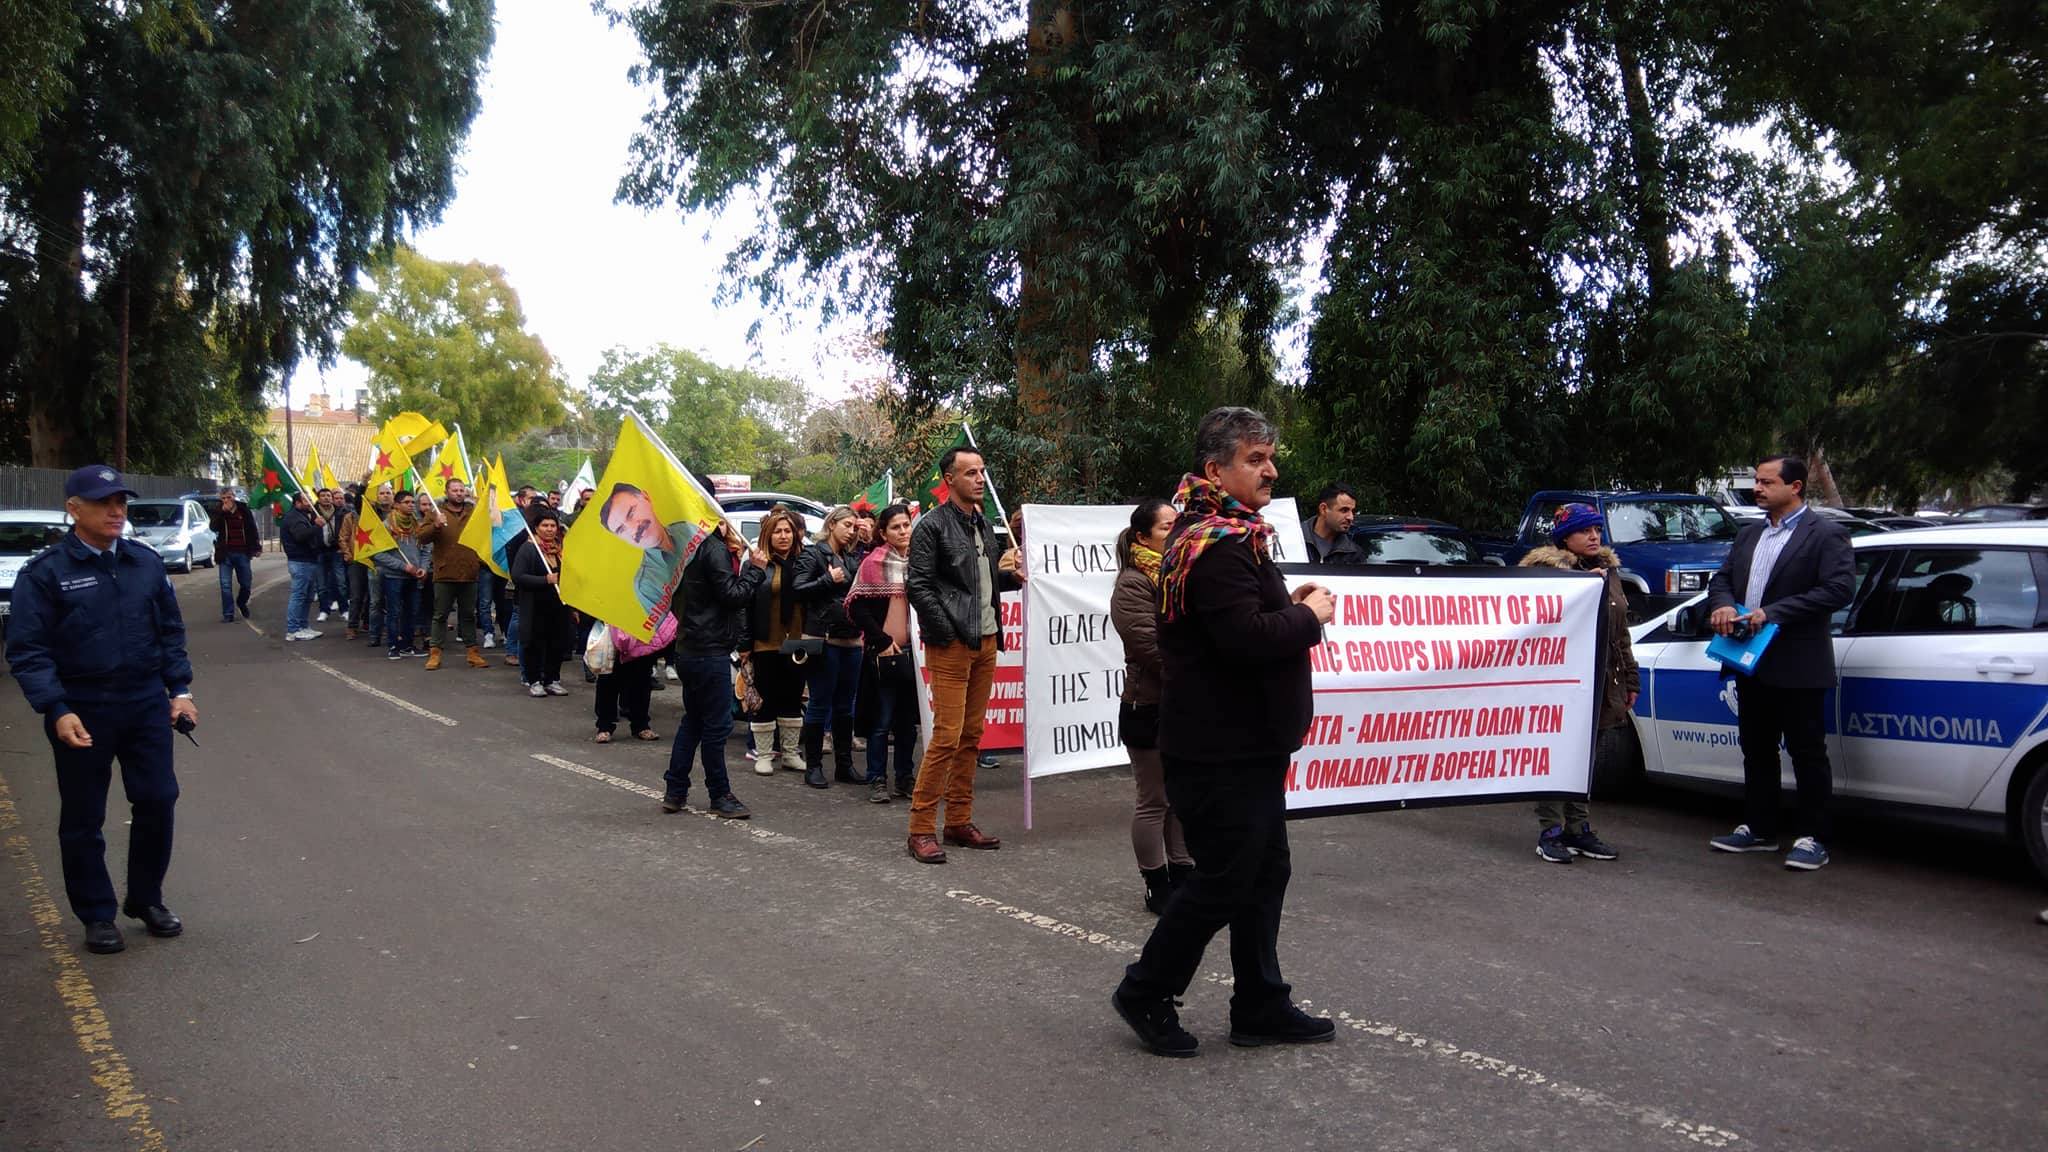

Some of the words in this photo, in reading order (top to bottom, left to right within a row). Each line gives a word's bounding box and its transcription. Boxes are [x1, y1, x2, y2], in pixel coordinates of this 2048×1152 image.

[1043, 543, 1060, 574] Η
[1343, 594, 1384, 626] AND
[1388, 594, 1502, 626] SOLIDARITY
[1507, 594, 1531, 625] OF
[1535, 594, 1563, 625] ALL
[1048, 613, 1109, 646] ΘΕΛΕΙ
[1345, 639, 1429, 672] GROUPS
[1431, 639, 1454, 671] IN
[1457, 638, 1519, 670] NORTH
[1517, 636, 1567, 667] SYRIA
[1048, 671, 1090, 705] ΤΗΣ
[1356, 708, 1474, 744] ΑΛΛΗΛΕΓΓΥΗ
[1475, 706, 1526, 737] ΟΛΩΝ
[1528, 704, 1564, 734] ΤΩΝ
[1847, 711, 2003, 744] ΑΣΤΥΝΟΜΙΑ
[1305, 756, 1393, 791] ΟΜΑΔΩΝ
[1391, 753, 1430, 785] ΣΤΗ
[1430, 749, 1497, 782] ΒΟΡΕΙΑ
[1499, 747, 1551, 778] ΣΥΡΙΑ
